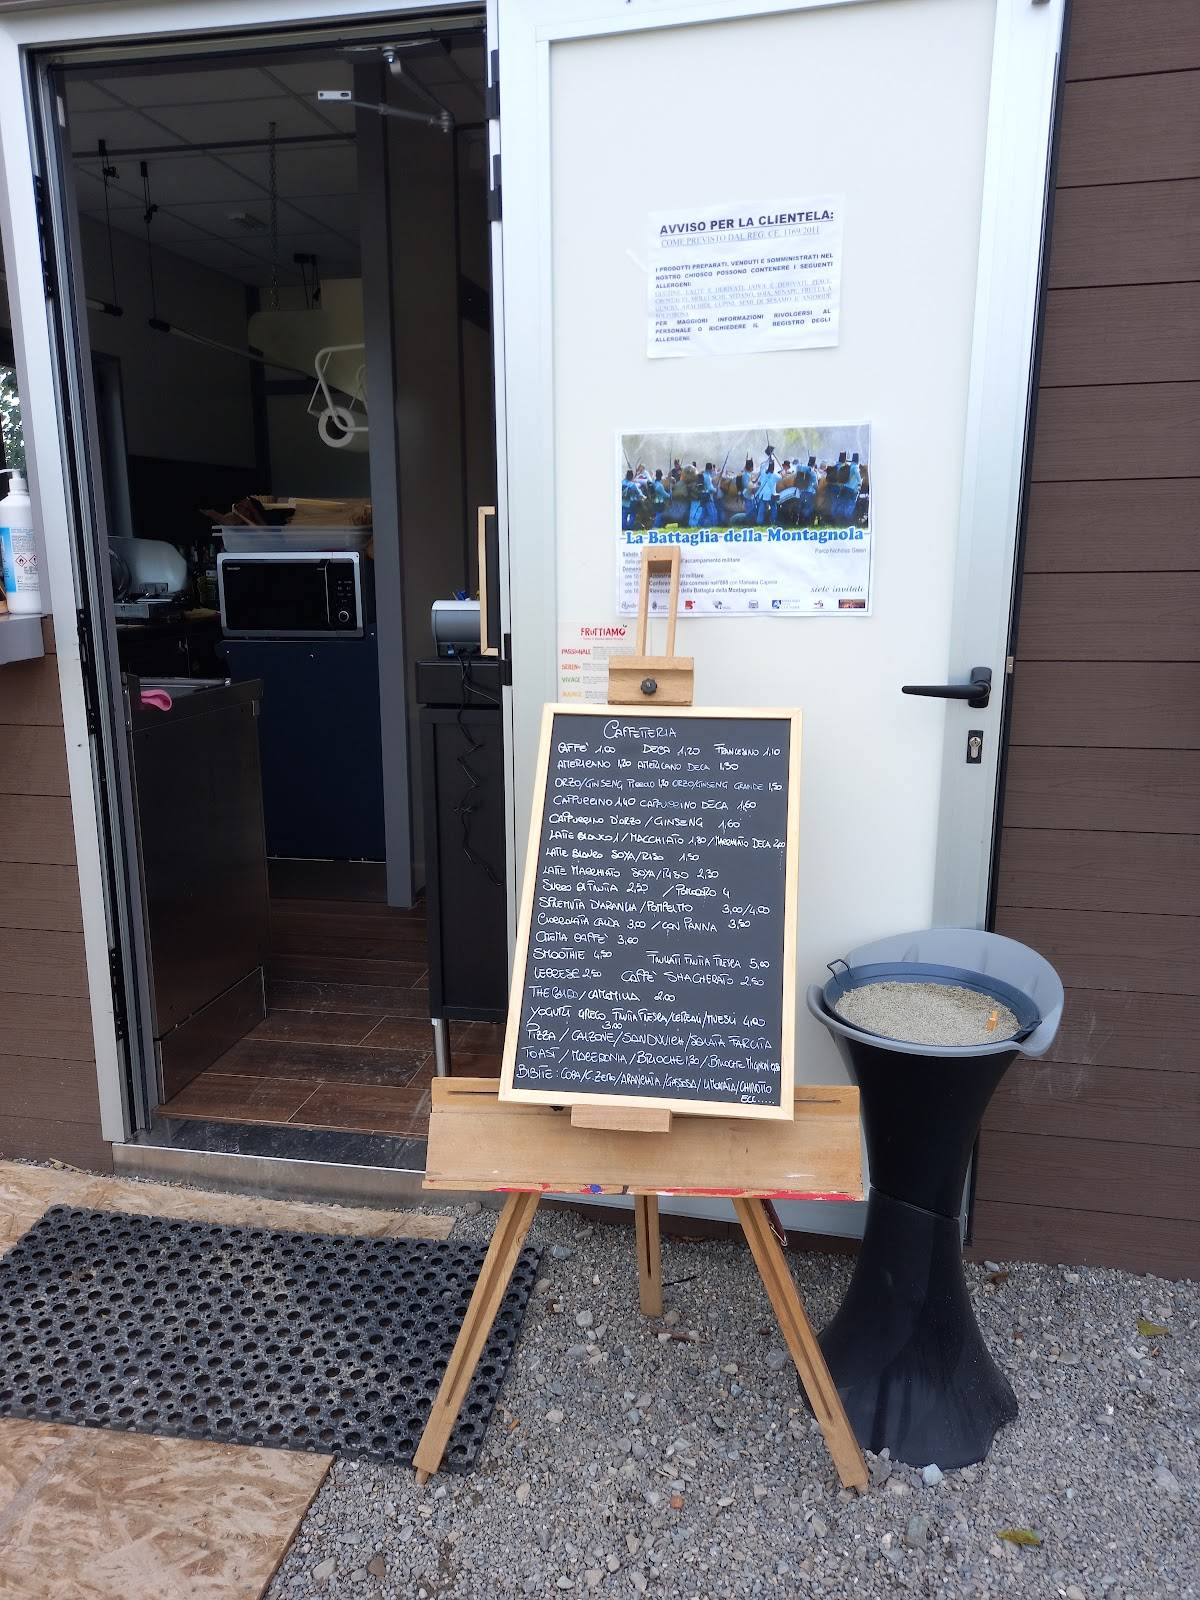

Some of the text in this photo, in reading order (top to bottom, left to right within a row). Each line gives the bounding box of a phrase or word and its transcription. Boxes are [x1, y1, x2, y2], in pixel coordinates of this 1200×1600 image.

[659, 209, 835, 235] AVVISO PER LA CLIENTELA:
[726, 232, 746, 243] DAL
[655, 273, 682, 282] NOSTRO
[684, 271, 713, 280] CHIOSCO
[715, 269, 747, 277] POSSONO
[750, 264, 790, 274] CONTENERE
[799, 261, 834, 271] SEGUENTI
[659, 265, 692, 273] PRODOTTI
[730, 259, 760, 268] VENDUTI
[766, 254, 820, 265] SOMMINISTRATI
[820, 252, 834, 260] NEL
[655, 307, 832, 327] PER MAGGIORI INFORMAZIONI RIVOLGERSI AL
[655, 326, 692, 335] PERSONALE
[708, 322, 747, 333] RICHIEDERE
[772, 318, 805, 328] REGISTRO
[811, 315, 832, 325] DEGLI
[624, 525, 865, 547] La Battaglia della Montagnola
[603, 719, 677, 739] CAFFETTERIA
[594, 745, 616, 754] 1,00
[642, 743, 671, 756] DECA
[677, 746, 701, 757] 1,20
[763, 746, 782, 757] 1,10
[556, 758, 611, 771] AMERICANO
[637, 759, 682, 771] AMERICANO
[687, 762, 711, 772] DECA
[733, 781, 763, 791] GRANDE
[768, 782, 783, 792] 1,50
[553, 794, 757, 813] CAPPUCCINO 1,40 CAPPUCCINO DECA 1,60
[548, 811, 605, 826] CAPPUCCINO
[717, 819, 741, 831] 1,60
[549, 829, 575, 841] LATTE
[752, 837, 772, 849] DECA
[545, 847, 569, 859] LATTE
[542, 864, 568, 877] LATTE
[570, 864, 621, 878] MACCHIATO
[697, 867, 720, 880] 2,30
[542, 878, 572, 892] SUCCO
[626, 881, 650, 894] 2,50
[538, 896, 586, 911] SPREMUTA
[537, 912, 590, 926] CIOCCOLATA
[593, 916, 621, 928] CALDA
[626, 919, 647, 930] 3,00
[683, 916, 718, 932] PANNA
[728, 918, 752, 930] 3,50
[535, 930, 569, 943] CREMA
[617, 934, 640, 946] 3,00
[532, 946, 586, 960] SMOOTHIE
[593, 949, 613, 960] 4,50
[748, 957, 771, 970] 5,00
[739, 975, 765, 987] 2,50
[653, 990, 677, 1002] 2,00
[526, 1005, 573, 1024] YOGURT
[526, 1022, 556, 1042] PIZZA
[521, 1045, 560, 1059] TOAST
